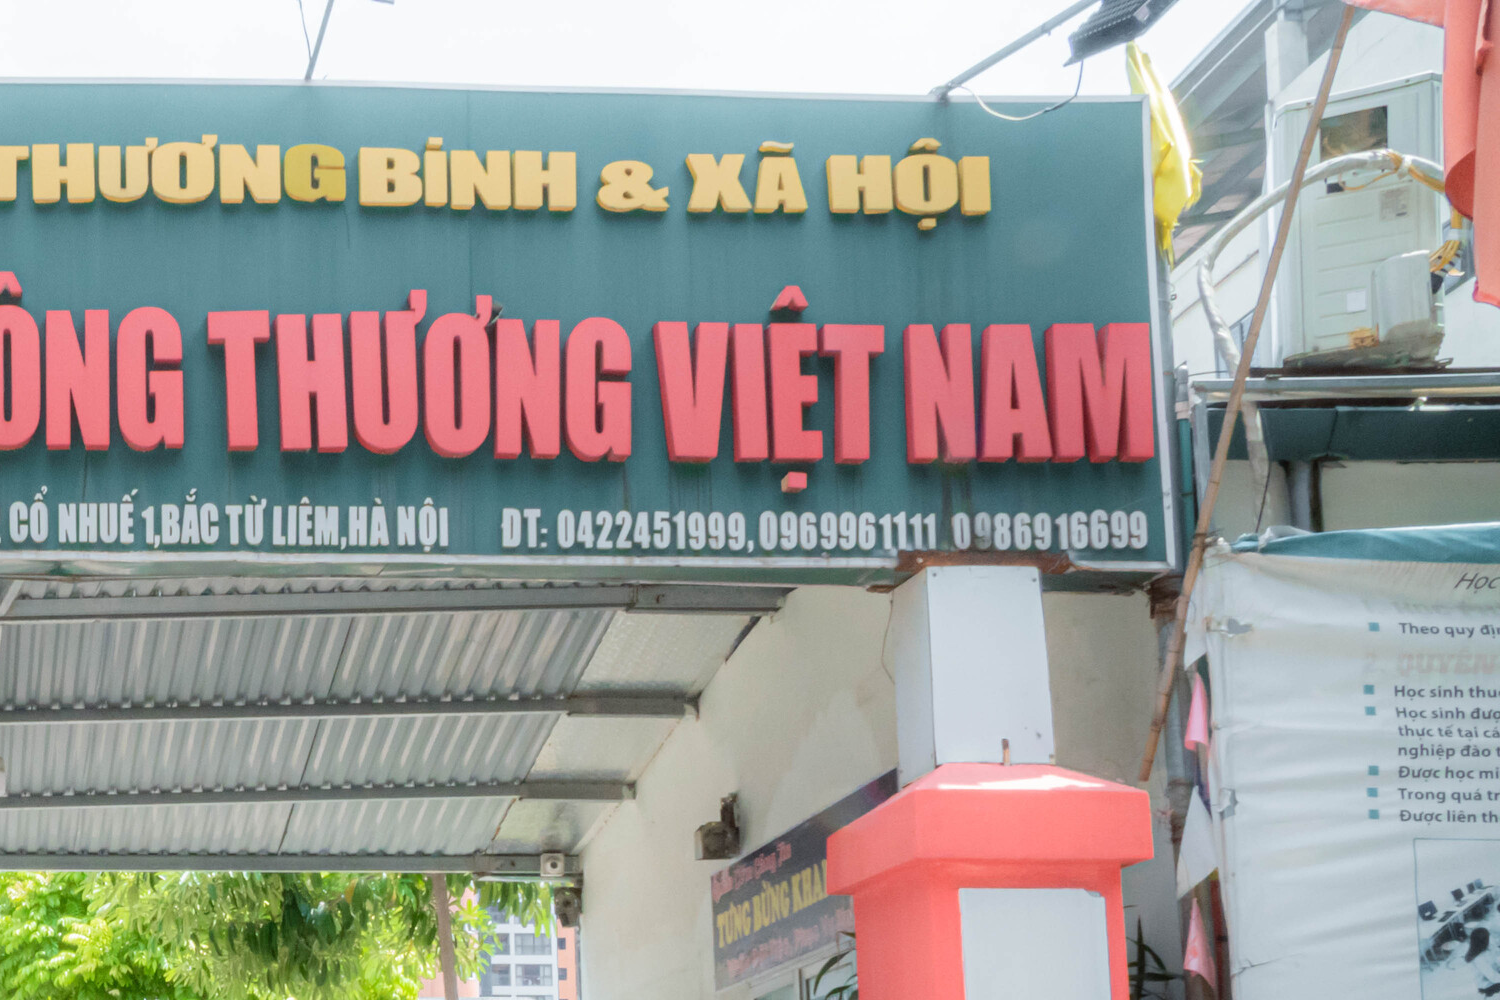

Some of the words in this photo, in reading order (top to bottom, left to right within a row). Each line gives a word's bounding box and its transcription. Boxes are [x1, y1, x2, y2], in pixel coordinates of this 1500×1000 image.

[597, 159, 670, 213] &
[687, 141, 808, 214] XÃ
[827, 138, 992, 230] HỘI
[207, 289, 632, 461] THƯƠNG
[653, 286, 886, 492] VIỆT
[903, 322, 1154, 464] NAM
[9, 485, 49, 544] CỔ
[58, 488, 138, 545] NHUẾ
[225, 495, 267, 545] TỪ
[397, 497, 449, 552] NỘI
[501, 507, 548, 549] ĐT:
[952, 509, 1148, 551] 0986916699
[1453, 573, 1500, 594] Học
[1399, 622, 1440, 635] Theo
[1444, 627, 1475, 639] quy
[1394, 685, 1425, 701] Học
[1430, 685, 1464, 699] sinh
[1395, 707, 1427, 722] Học
[1431, 707, 1466, 720] sinh
[1398, 724, 1434, 741] thực
[1437, 723, 1454, 738] tế
[1457, 726, 1479, 741] tại
[1398, 743, 1456, 761] nghiệp
[1460, 744, 1491, 758] đào
[1398, 765, 1441, 782] Được
[1445, 765, 1475, 782] học
[1397, 787, 1446, 804] Trong
[1451, 787, 1482, 804] quá
[1400, 809, 1443, 826] Được
[1447, 809, 1477, 823] liên
[716, 900, 751, 949] TỪNG
[752, 880, 791, 934] BỪNG
